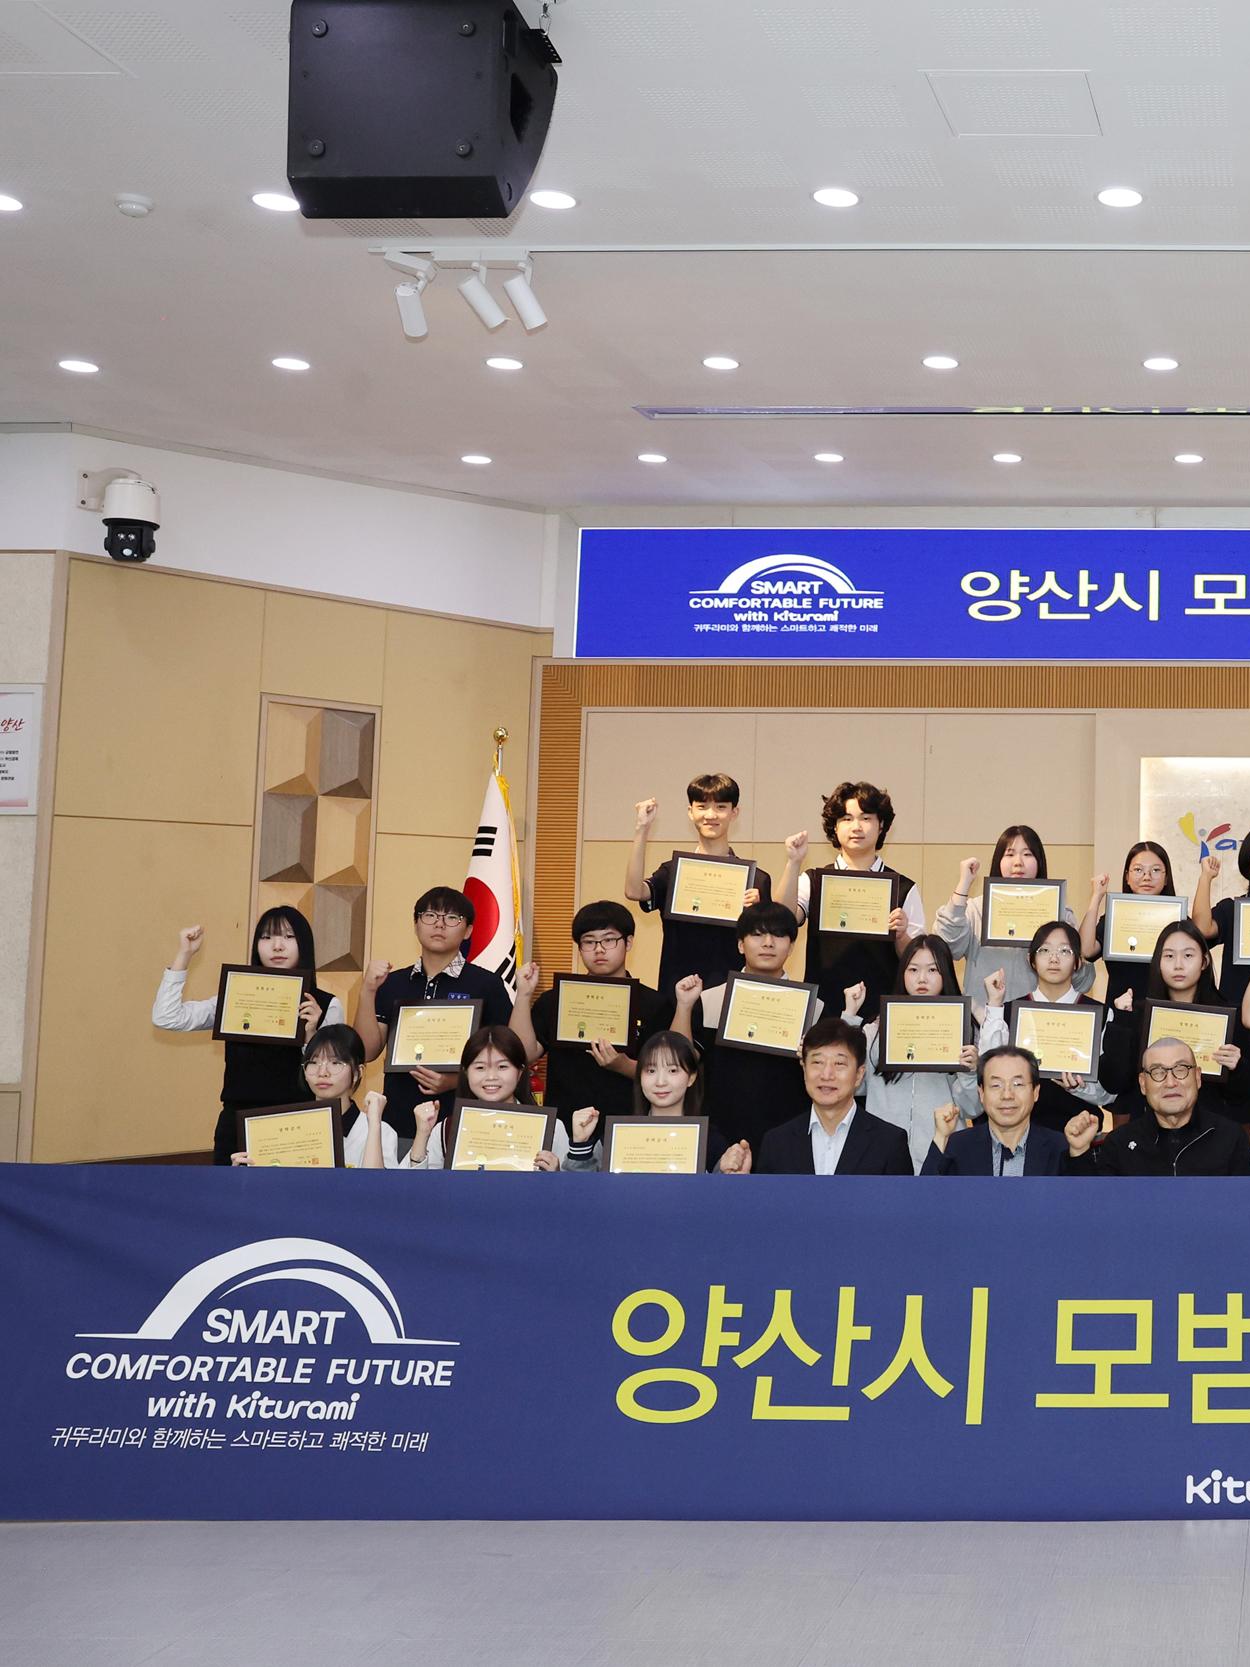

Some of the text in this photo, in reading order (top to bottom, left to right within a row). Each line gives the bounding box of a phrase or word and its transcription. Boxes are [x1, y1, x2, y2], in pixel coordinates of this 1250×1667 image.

[688, 597, 884, 609] COMFORTABLE FUTURE
[750, 580, 824, 595] SMART
[960, 569, 1160, 622] 양산시
[733, 609, 840, 622] with Kiturami
[201, 1307, 347, 1346] SMART
[65, 1352, 455, 1387] COMFORTABLE FUTURE
[611, 1285, 989, 1425] 양산시
[147, 1390, 361, 1421] with Kiturami
[51, 1426, 430, 1453] 귀뚜라미와 함께하는 스마트하고 쾌적한 미래
